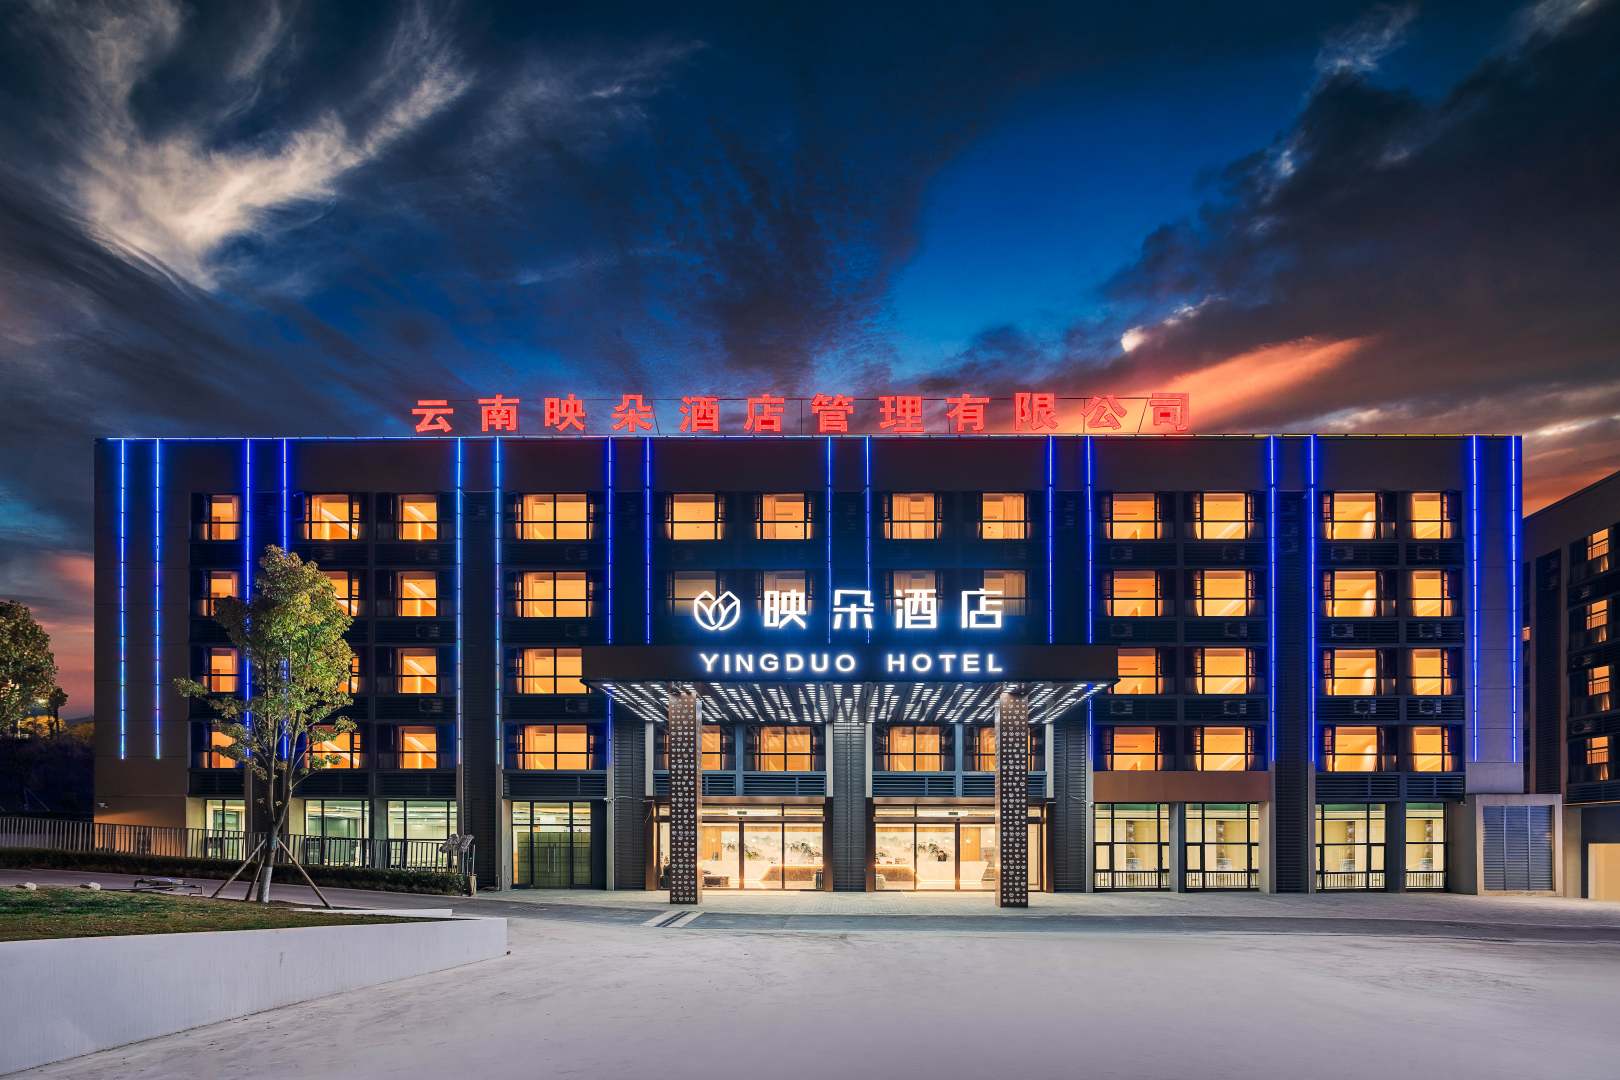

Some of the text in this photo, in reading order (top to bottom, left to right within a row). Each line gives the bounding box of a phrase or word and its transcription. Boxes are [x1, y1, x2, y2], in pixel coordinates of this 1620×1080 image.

[412, 392, 1190, 432] 云南映朵酒店管理有限公司
[763, 588, 1003, 629] 映朵酒店
[700, 653, 1003, 673] YINGDUO HOTEL
